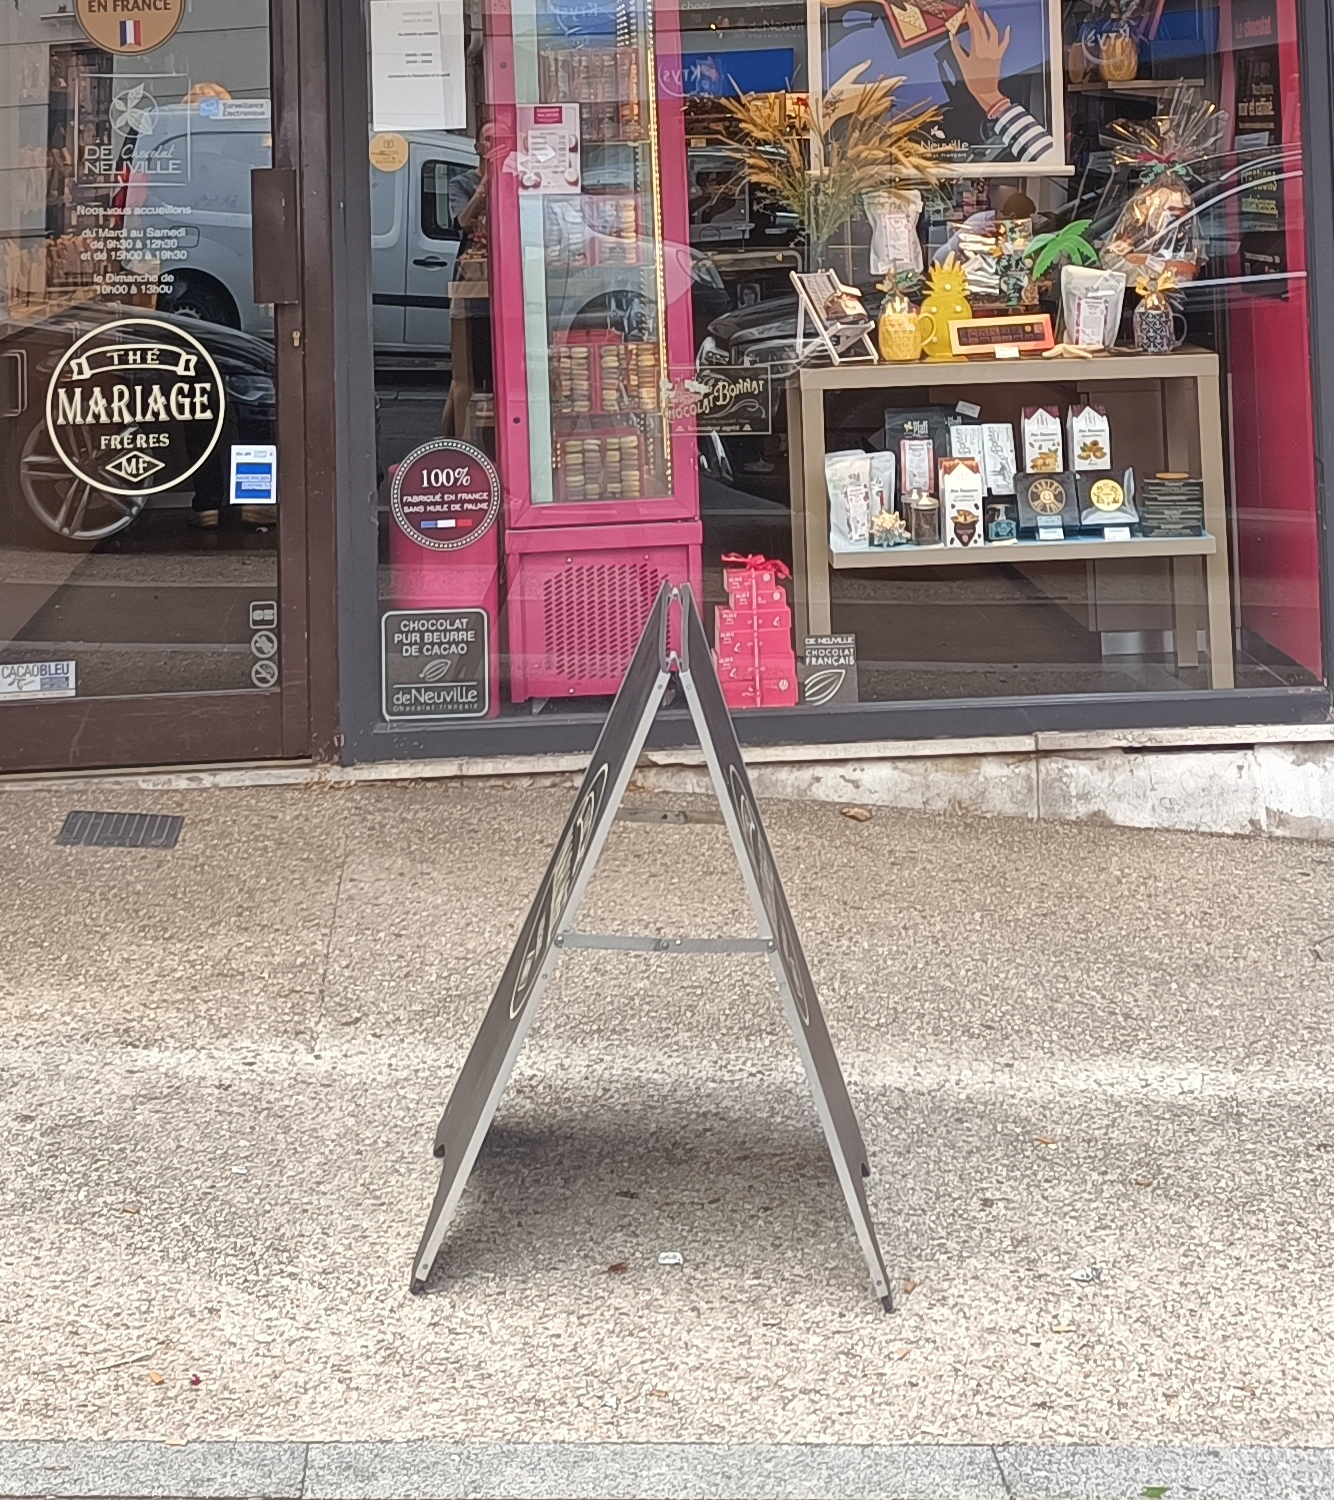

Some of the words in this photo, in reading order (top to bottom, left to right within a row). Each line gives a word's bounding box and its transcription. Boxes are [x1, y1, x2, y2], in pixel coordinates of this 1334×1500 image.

[87, 0, 108, 13] EN
[84, 145, 113, 160] DE
[84, 160, 182, 174] NEUVILLE
[98, 228, 128, 238] Mardi
[130, 230, 144, 238] au
[146, 227, 186, 238] Samedi
[90, 239, 104, 249] de
[106, 239, 133, 249] 9h30
[146, 239, 178, 249] 12h30
[80, 251, 91, 260] et
[94, 250, 107, 260] de
[110, 250, 143, 260] 15h00
[155, 250, 188, 260] 19h30
[105, 273, 158, 283] Dimanche
[161, 272, 174, 282] de
[95, 285, 128, 294] 10h00
[106, 349, 161, 365] THÉ
[56, 382, 214, 426] MARIAGE
[665, 394, 715, 419] HOCOLAT
[120, 457, 150, 475] MF
[421, 466, 471, 488] 100%
[403, 493, 442, 503] FABRIQUÉ
[457, 492, 489, 500] FRANCE
[400, 618, 469, 632] CHOCOLAT
[394, 632, 421, 644] PUR
[424, 631, 476, 643] BEURRE
[402, 645, 420, 657] DE
[422, 643, 468, 656] CACAO
[805, 648, 854, 657] CHOCOLAT
[805, 656, 855, 666] FRANÇAIS
